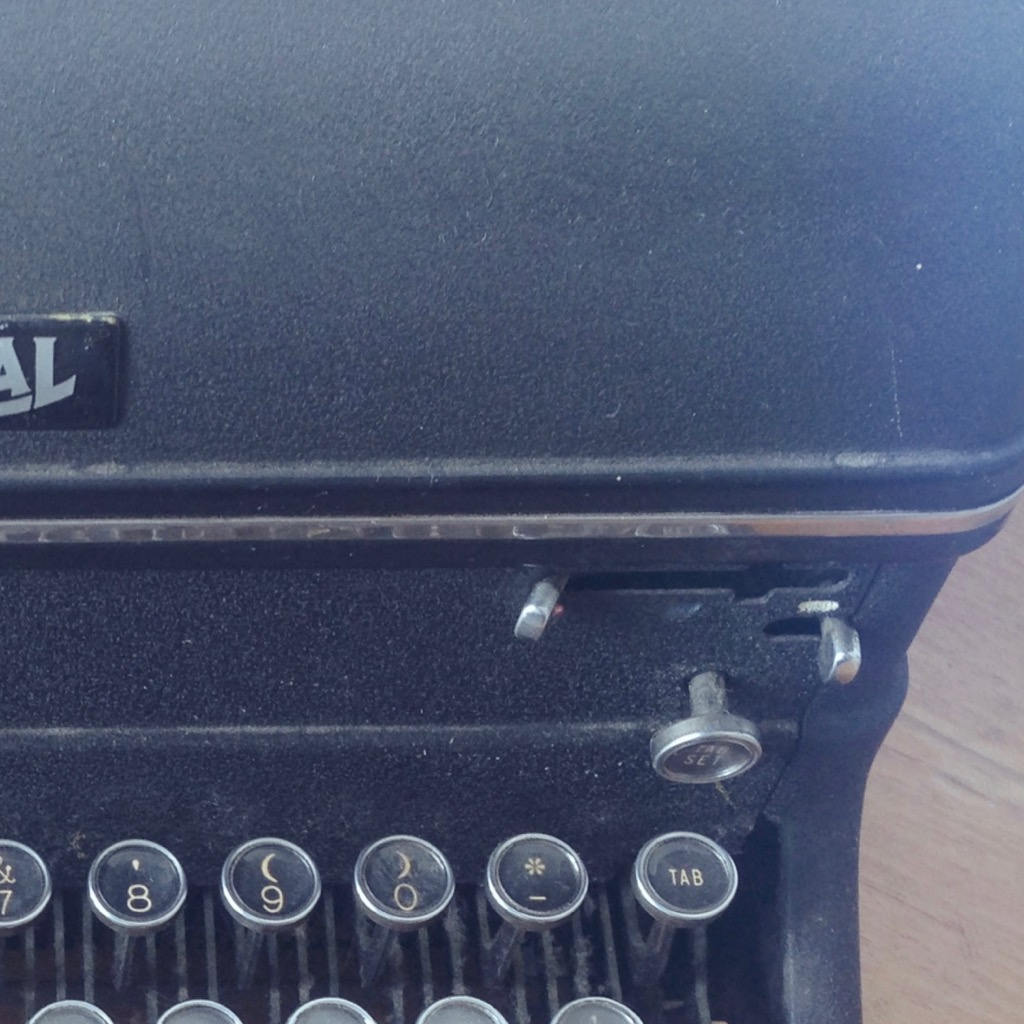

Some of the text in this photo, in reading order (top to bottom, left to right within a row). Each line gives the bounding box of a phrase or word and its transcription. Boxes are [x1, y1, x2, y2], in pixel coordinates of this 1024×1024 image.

[261, 853, 279, 883] (
[397, 851, 413, 881] )
[668, 868, 704, 887] TAB
[126, 883, 153, 914] 8
[260, 884, 285, 913] 9
